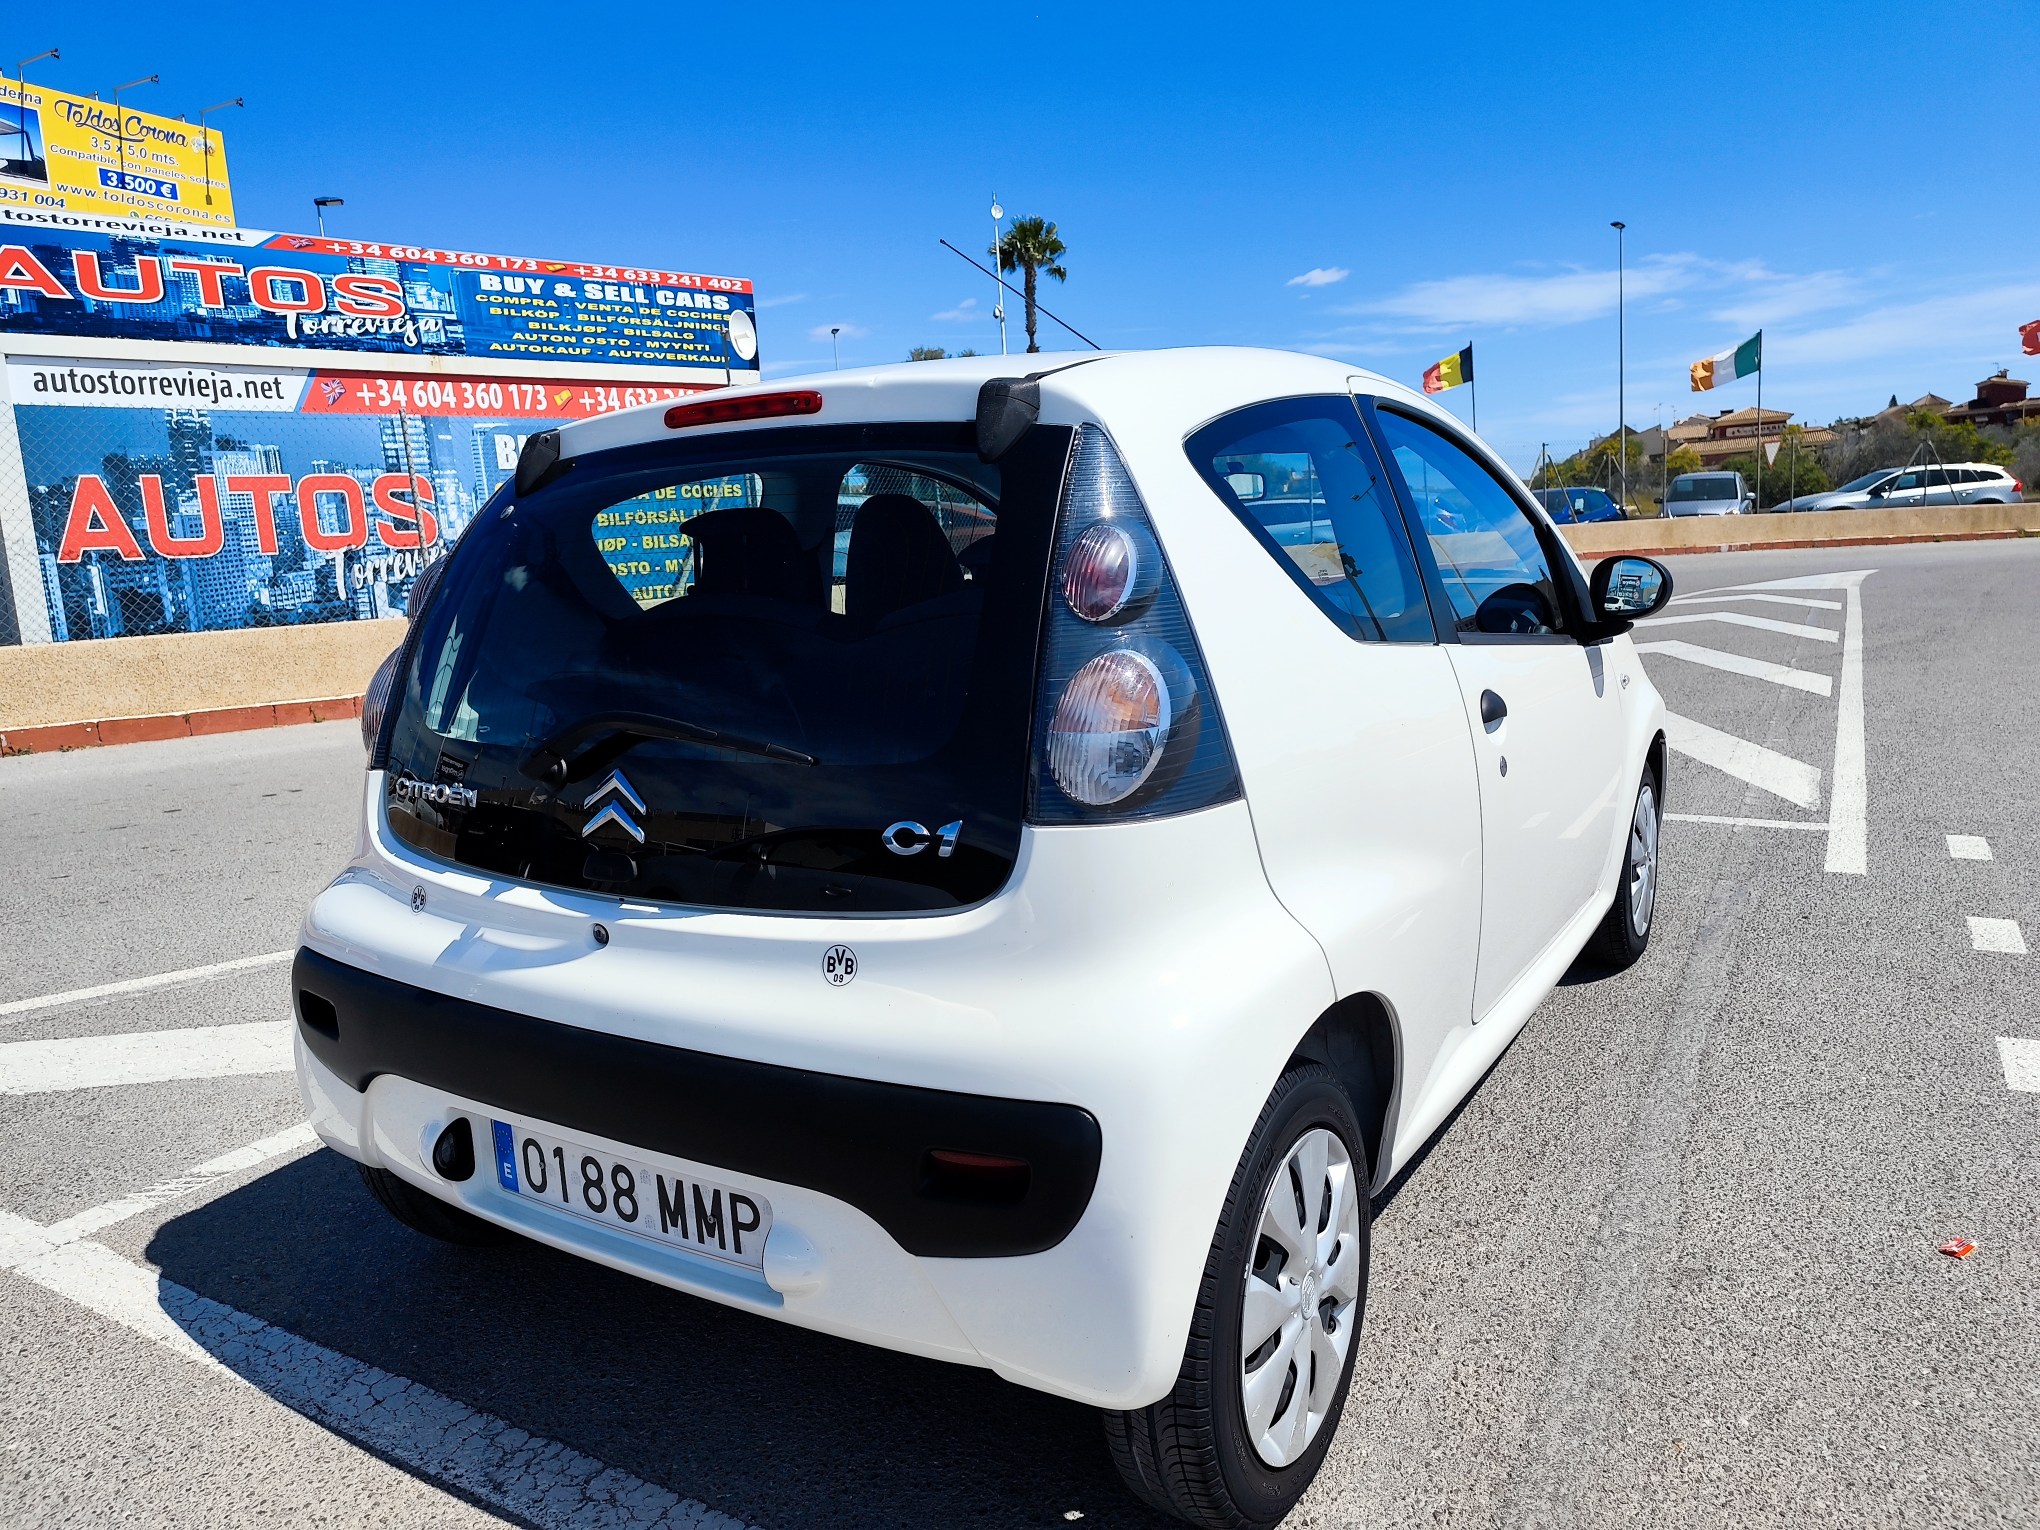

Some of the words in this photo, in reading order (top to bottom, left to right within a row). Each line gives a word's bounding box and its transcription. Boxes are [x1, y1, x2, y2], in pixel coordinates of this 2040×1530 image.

[54, 99, 122, 137] Toldos
[125, 115, 188, 147] Corona
[50, 144, 117, 166] Compatible
[121, 160, 141, 170] con
[145, 165, 186, 180] paneles
[190, 175, 226, 188] solares
[91, 136, 111, 151] 3,5
[128, 145, 147, 159] 5,0
[151, 152, 179, 166] mts.
[107, 172, 156, 194] 3.500
[161, 185, 173, 198] €
[35, 194, 65, 208] 004
[56, 183, 231, 223] www.toldoscorona.es
[2, 209, 245, 242] tostorrevieja.net
[326, 243, 382, 256] +34
[389, 247, 437, 261] 604
[445, 252, 489, 266] 360
[496, 257, 538, 271] 173
[574, 266, 618, 278] +34
[624, 270, 660, 282] 633
[667, 273, 702, 286] 241
[707, 279, 743, 291] 402
[475, 294, 558, 307] COMPRA
[575, 302, 634, 314] VENTA
[639, 307, 662, 316] DE
[667, 310, 731, 321] COCHES
[480, 274, 545, 295] BUY
[554, 283, 576, 297] &
[583, 283, 650, 304] SELL
[656, 290, 730, 310] CARS
[276, 311, 441, 347] Torrevieja
[490, 307, 560, 319] BILKÖP
[578, 314, 721, 331] BILFÖRSÄLJNING
[528, 322, 607, 333] BILKJØP
[624, 328, 695, 340] BILSALG
[490, 343, 591, 355] AUTOKAUF
[512, 333, 577, 343] AUTON
[583, 337, 630, 346] OSTO
[646, 341, 710, 352] MYYNTI
[33, 369, 285, 403] autostorrevieja.net
[356, 379, 408, 407] +34
[413, 380, 457, 408] 604
[461, 382, 503, 409] 360
[508, 384, 547, 411] 173
[579, 387, 620, 411] +34
[58, 473, 440, 563] AUTOS
[642, 534, 691, 549] BILSA
[396, 777, 478, 808] CITROËN
[881, 820, 963, 857] C1
[827, 948, 854, 975] BVB
[833, 973, 844, 983] 09
[503, 1162, 513, 1179] E
[522, 1137, 639, 1223] 0188
[656, 1174, 760, 1255] MMP
